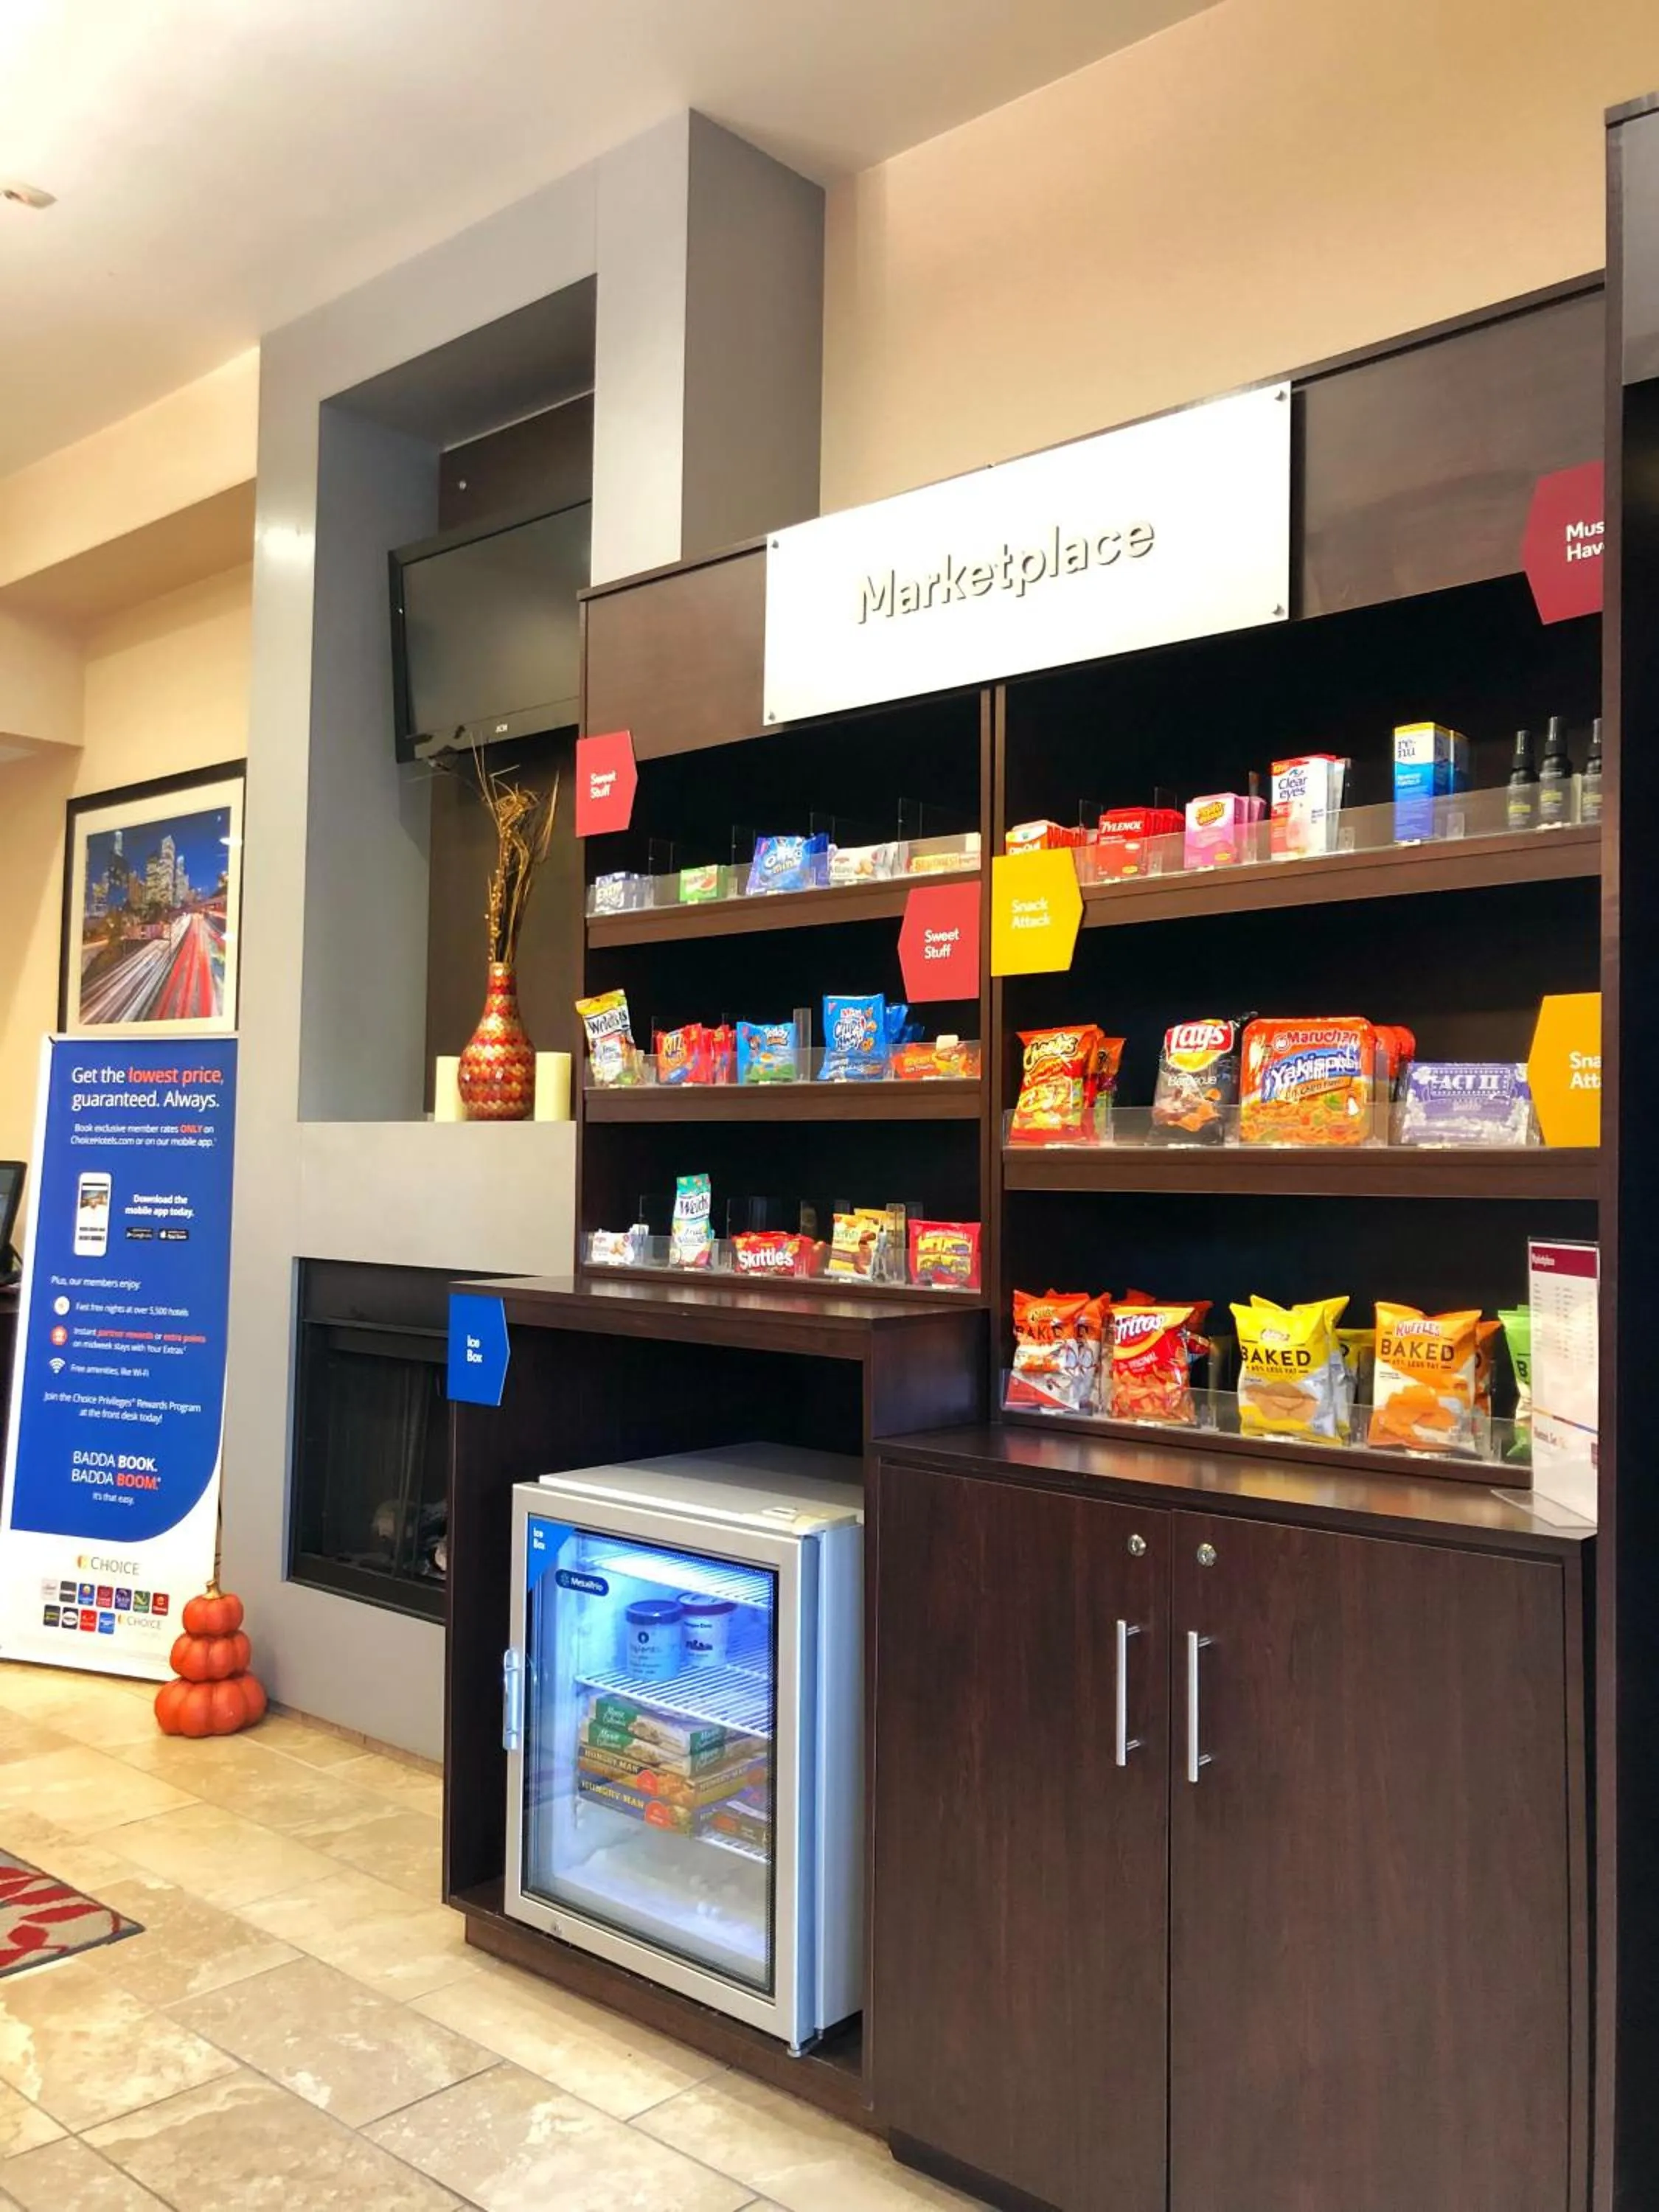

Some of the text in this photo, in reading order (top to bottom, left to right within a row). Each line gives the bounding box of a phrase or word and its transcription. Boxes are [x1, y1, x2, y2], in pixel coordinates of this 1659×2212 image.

[856, 520, 1155, 625] Marketplace
[590, 769, 616, 785] Sweet
[1278, 776, 1308, 790] Clear
[590, 785, 611, 799] Stuff
[1279, 787, 1306, 801] eyes
[1102, 820, 1144, 834] TYLENOL
[1011, 897, 1048, 914] Snack
[1011, 912, 1051, 930] Attack
[924, 927, 960, 943] Sweet
[924, 943, 952, 959] Stuff
[1287, 1030, 1358, 1043] Maruchan
[72, 1066, 223, 1087] Get the lowest price,
[1439, 1074, 1501, 1091] ACT II
[72, 1090, 220, 1112] guaranteed. Always.
[74, 1123, 93, 1133] Book
[94, 1123, 126, 1133] exclusive
[128, 1124, 159, 1133] member
[160, 1124, 178, 1133] rates
[179, 1124, 203, 1133] ONLY
[135, 1137, 144, 1145] or
[145, 1137, 156, 1145] on
[156, 1138, 170, 1146] our
[170, 1136, 196, 1147] mobile
[133, 1194, 188, 1204] Download the
[125, 1206, 195, 1219] mobile app today.
[737, 1247, 794, 1270] Skittles
[69, 1277, 83, 1286] our
[83, 1277, 118, 1288] members
[90, 1303, 104, 1312] free
[133, 1307, 148, 1315] over
[467, 1334, 481, 1349] Ice
[467, 1349, 484, 1363] Box
[1239, 1346, 1312, 1367] BAKED
[1381, 1338, 1455, 1362] BAKED
[43, 1391, 58, 1402] Join
[59, 1393, 72, 1402] the
[72, 1393, 97, 1405] Choice
[136, 1399, 168, 1411] Rewards
[169, 1401, 201, 1413] Program
[79, 1409, 88, 1417] at
[88, 1408, 101, 1418] the
[102, 1409, 120, 1419] front
[121, 1411, 138, 1421] desk
[72, 1450, 158, 1472] BADDA BOOK.
[71, 1468, 114, 1486] BADDA
[102, 1492, 117, 1502] that
[533, 1526, 544, 1539] Ice
[533, 1537, 546, 1550] Box
[90, 1556, 140, 1576] CHOICE
[126, 1615, 162, 1630] CHOICE
